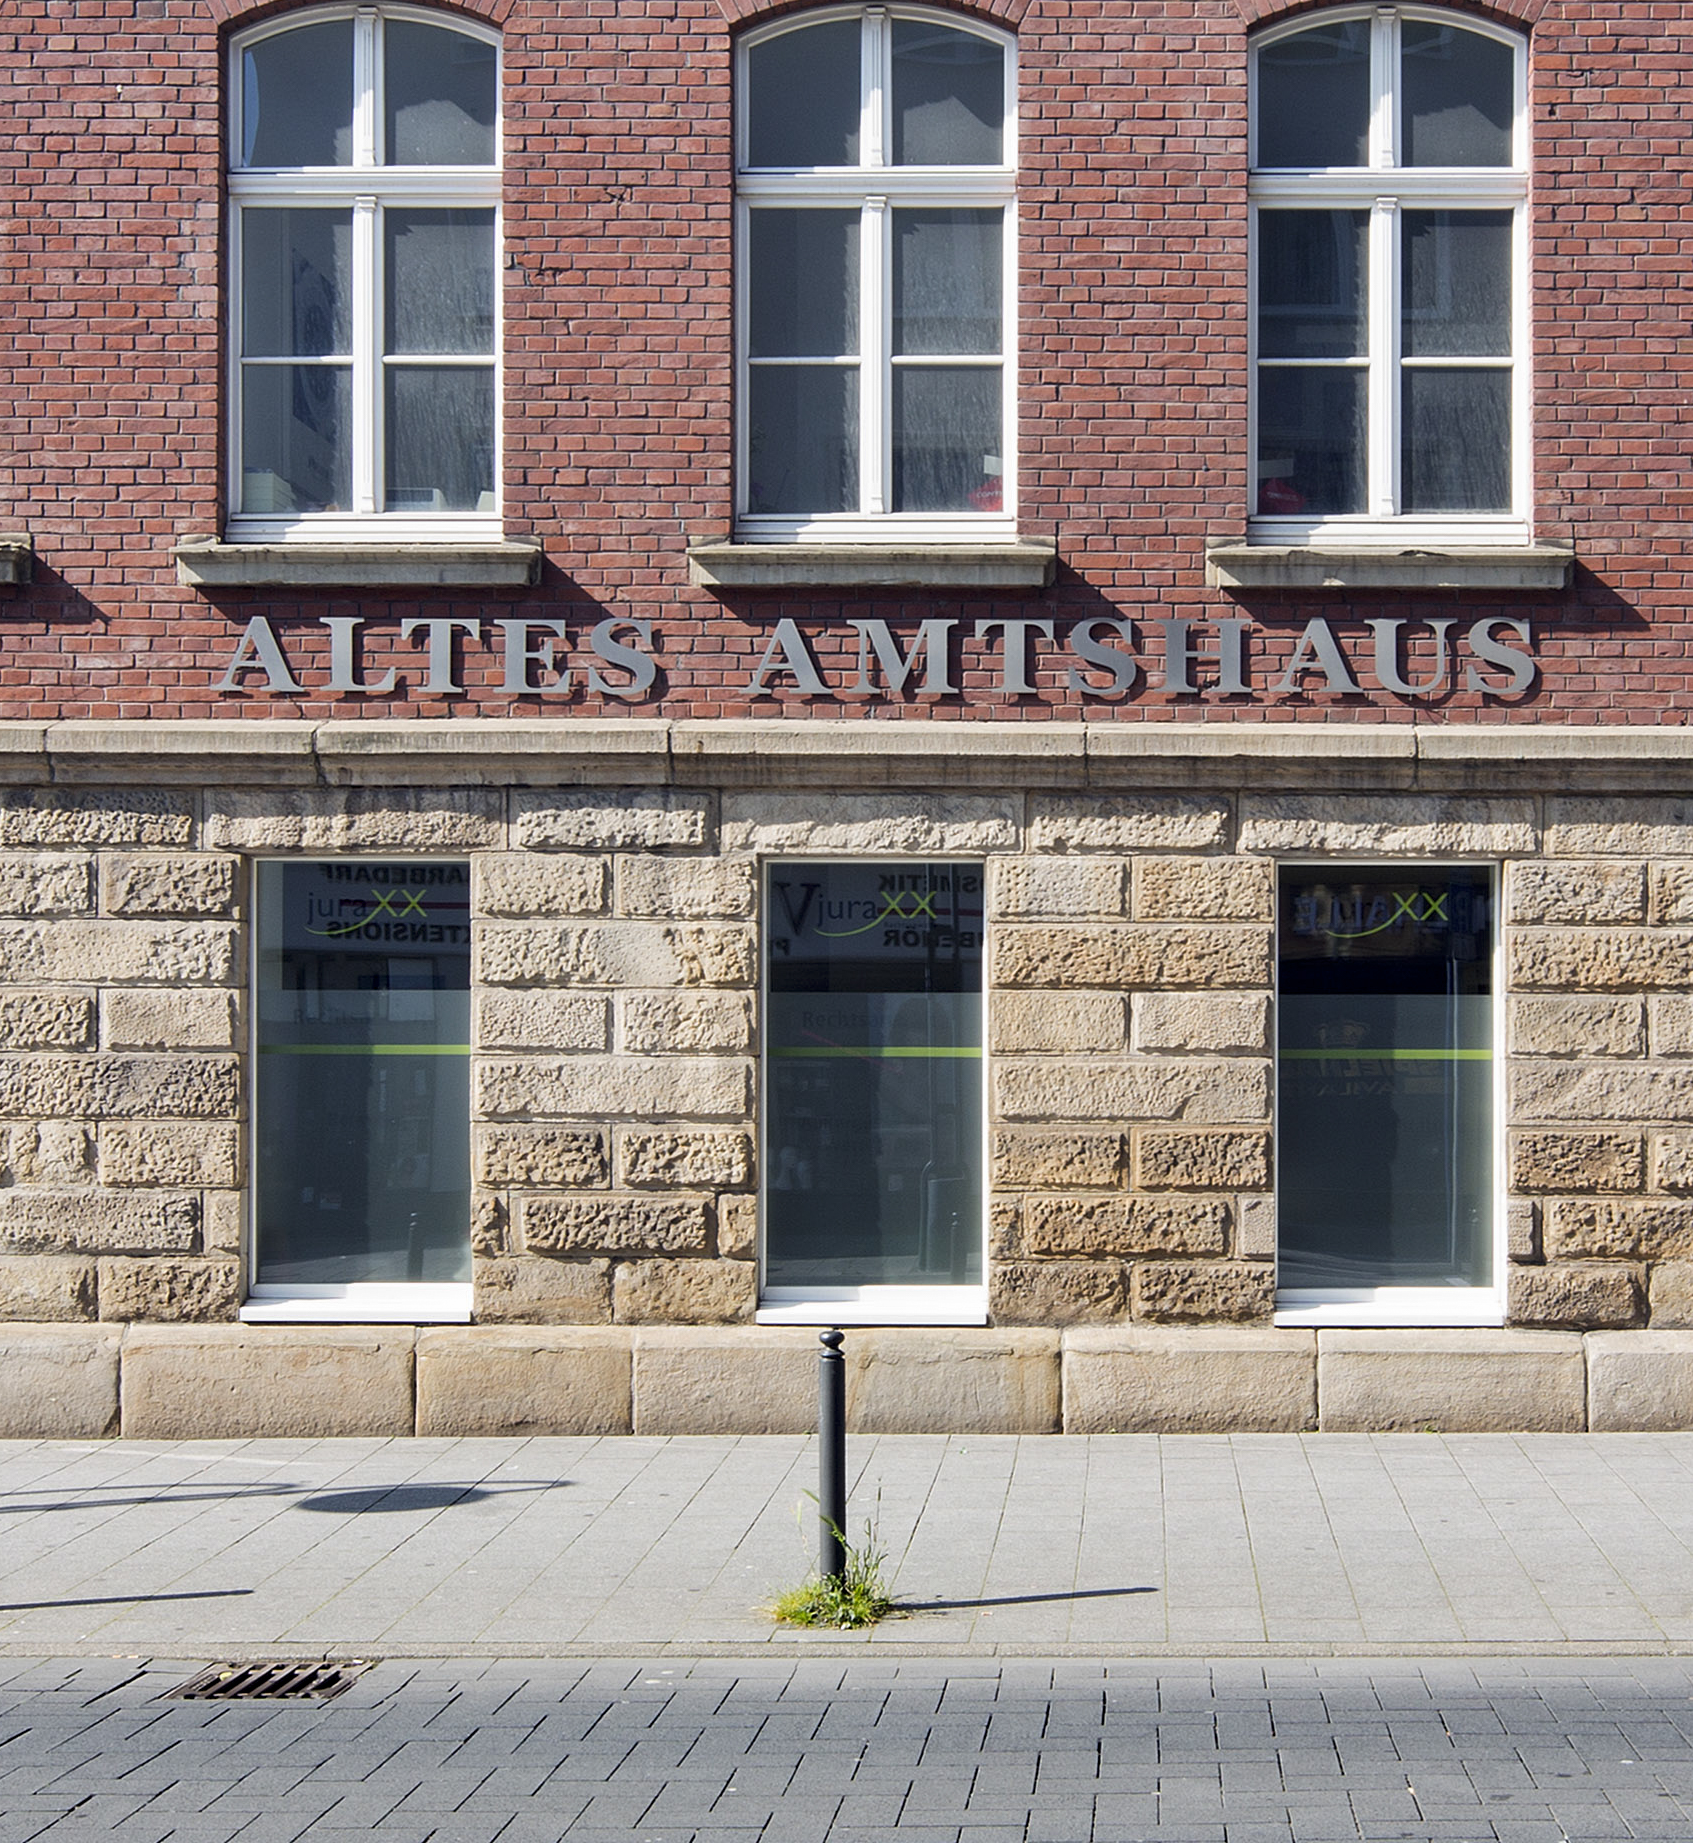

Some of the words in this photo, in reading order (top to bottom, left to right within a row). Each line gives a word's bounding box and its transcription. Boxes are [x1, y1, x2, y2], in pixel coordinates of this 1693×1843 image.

[209, 616, 657, 696] ALTES
[739, 616, 1537, 697] AMTSHAUS
[305, 889, 428, 932] juraXX
[815, 891, 938, 933] juraXX
